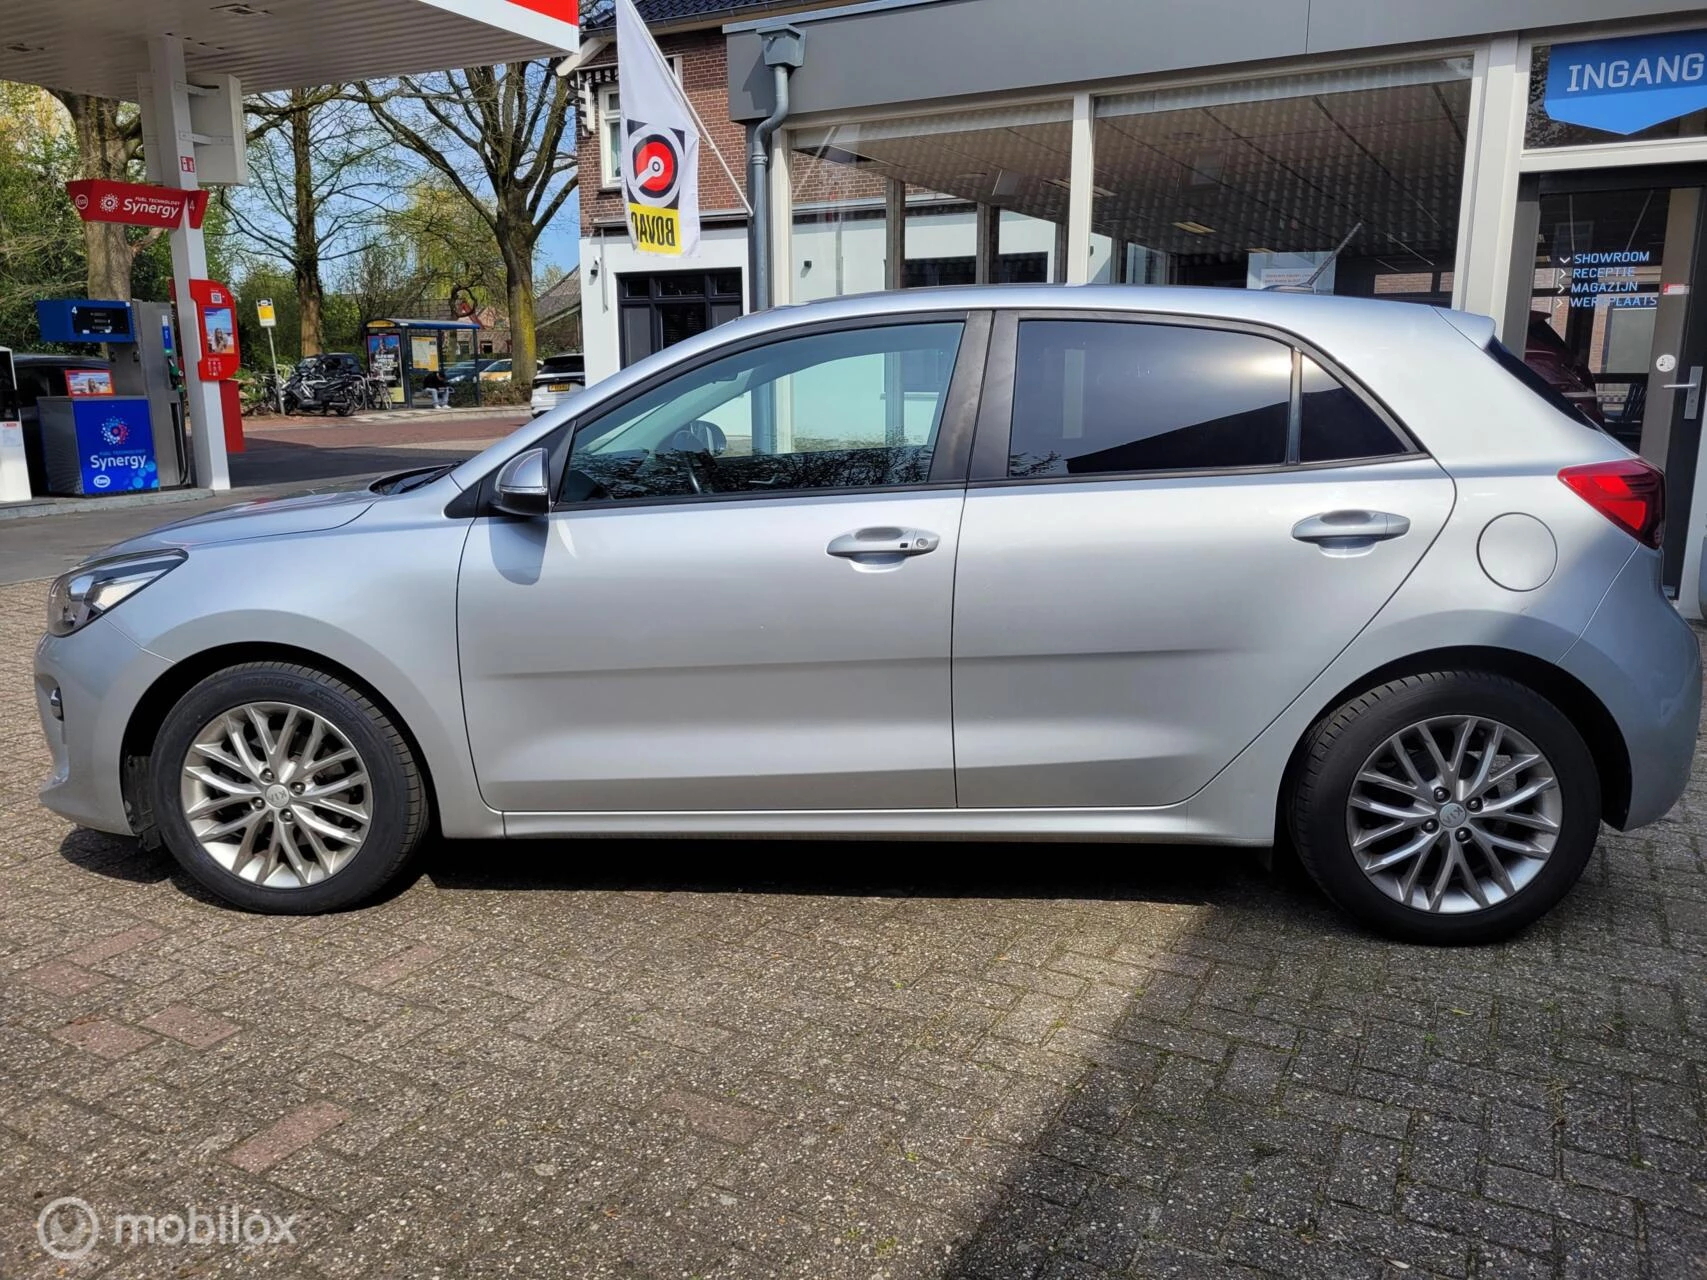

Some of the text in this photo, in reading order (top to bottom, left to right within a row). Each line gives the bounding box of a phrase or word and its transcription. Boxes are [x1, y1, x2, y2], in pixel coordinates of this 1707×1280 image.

[1566, 52, 1705, 92] INGANG
[123, 198, 179, 218] Synergy
[189, 199, 196, 210] 4
[1574, 251, 1650, 264] SHOWROOM
[1572, 266, 1637, 279] RECEPTIE
[1571, 281, 1638, 293] MAGAZIJN
[1570, 295, 1657, 308] WERPLAATS
[71, 306, 78, 314] 4
[90, 455, 147, 471] Synergy
